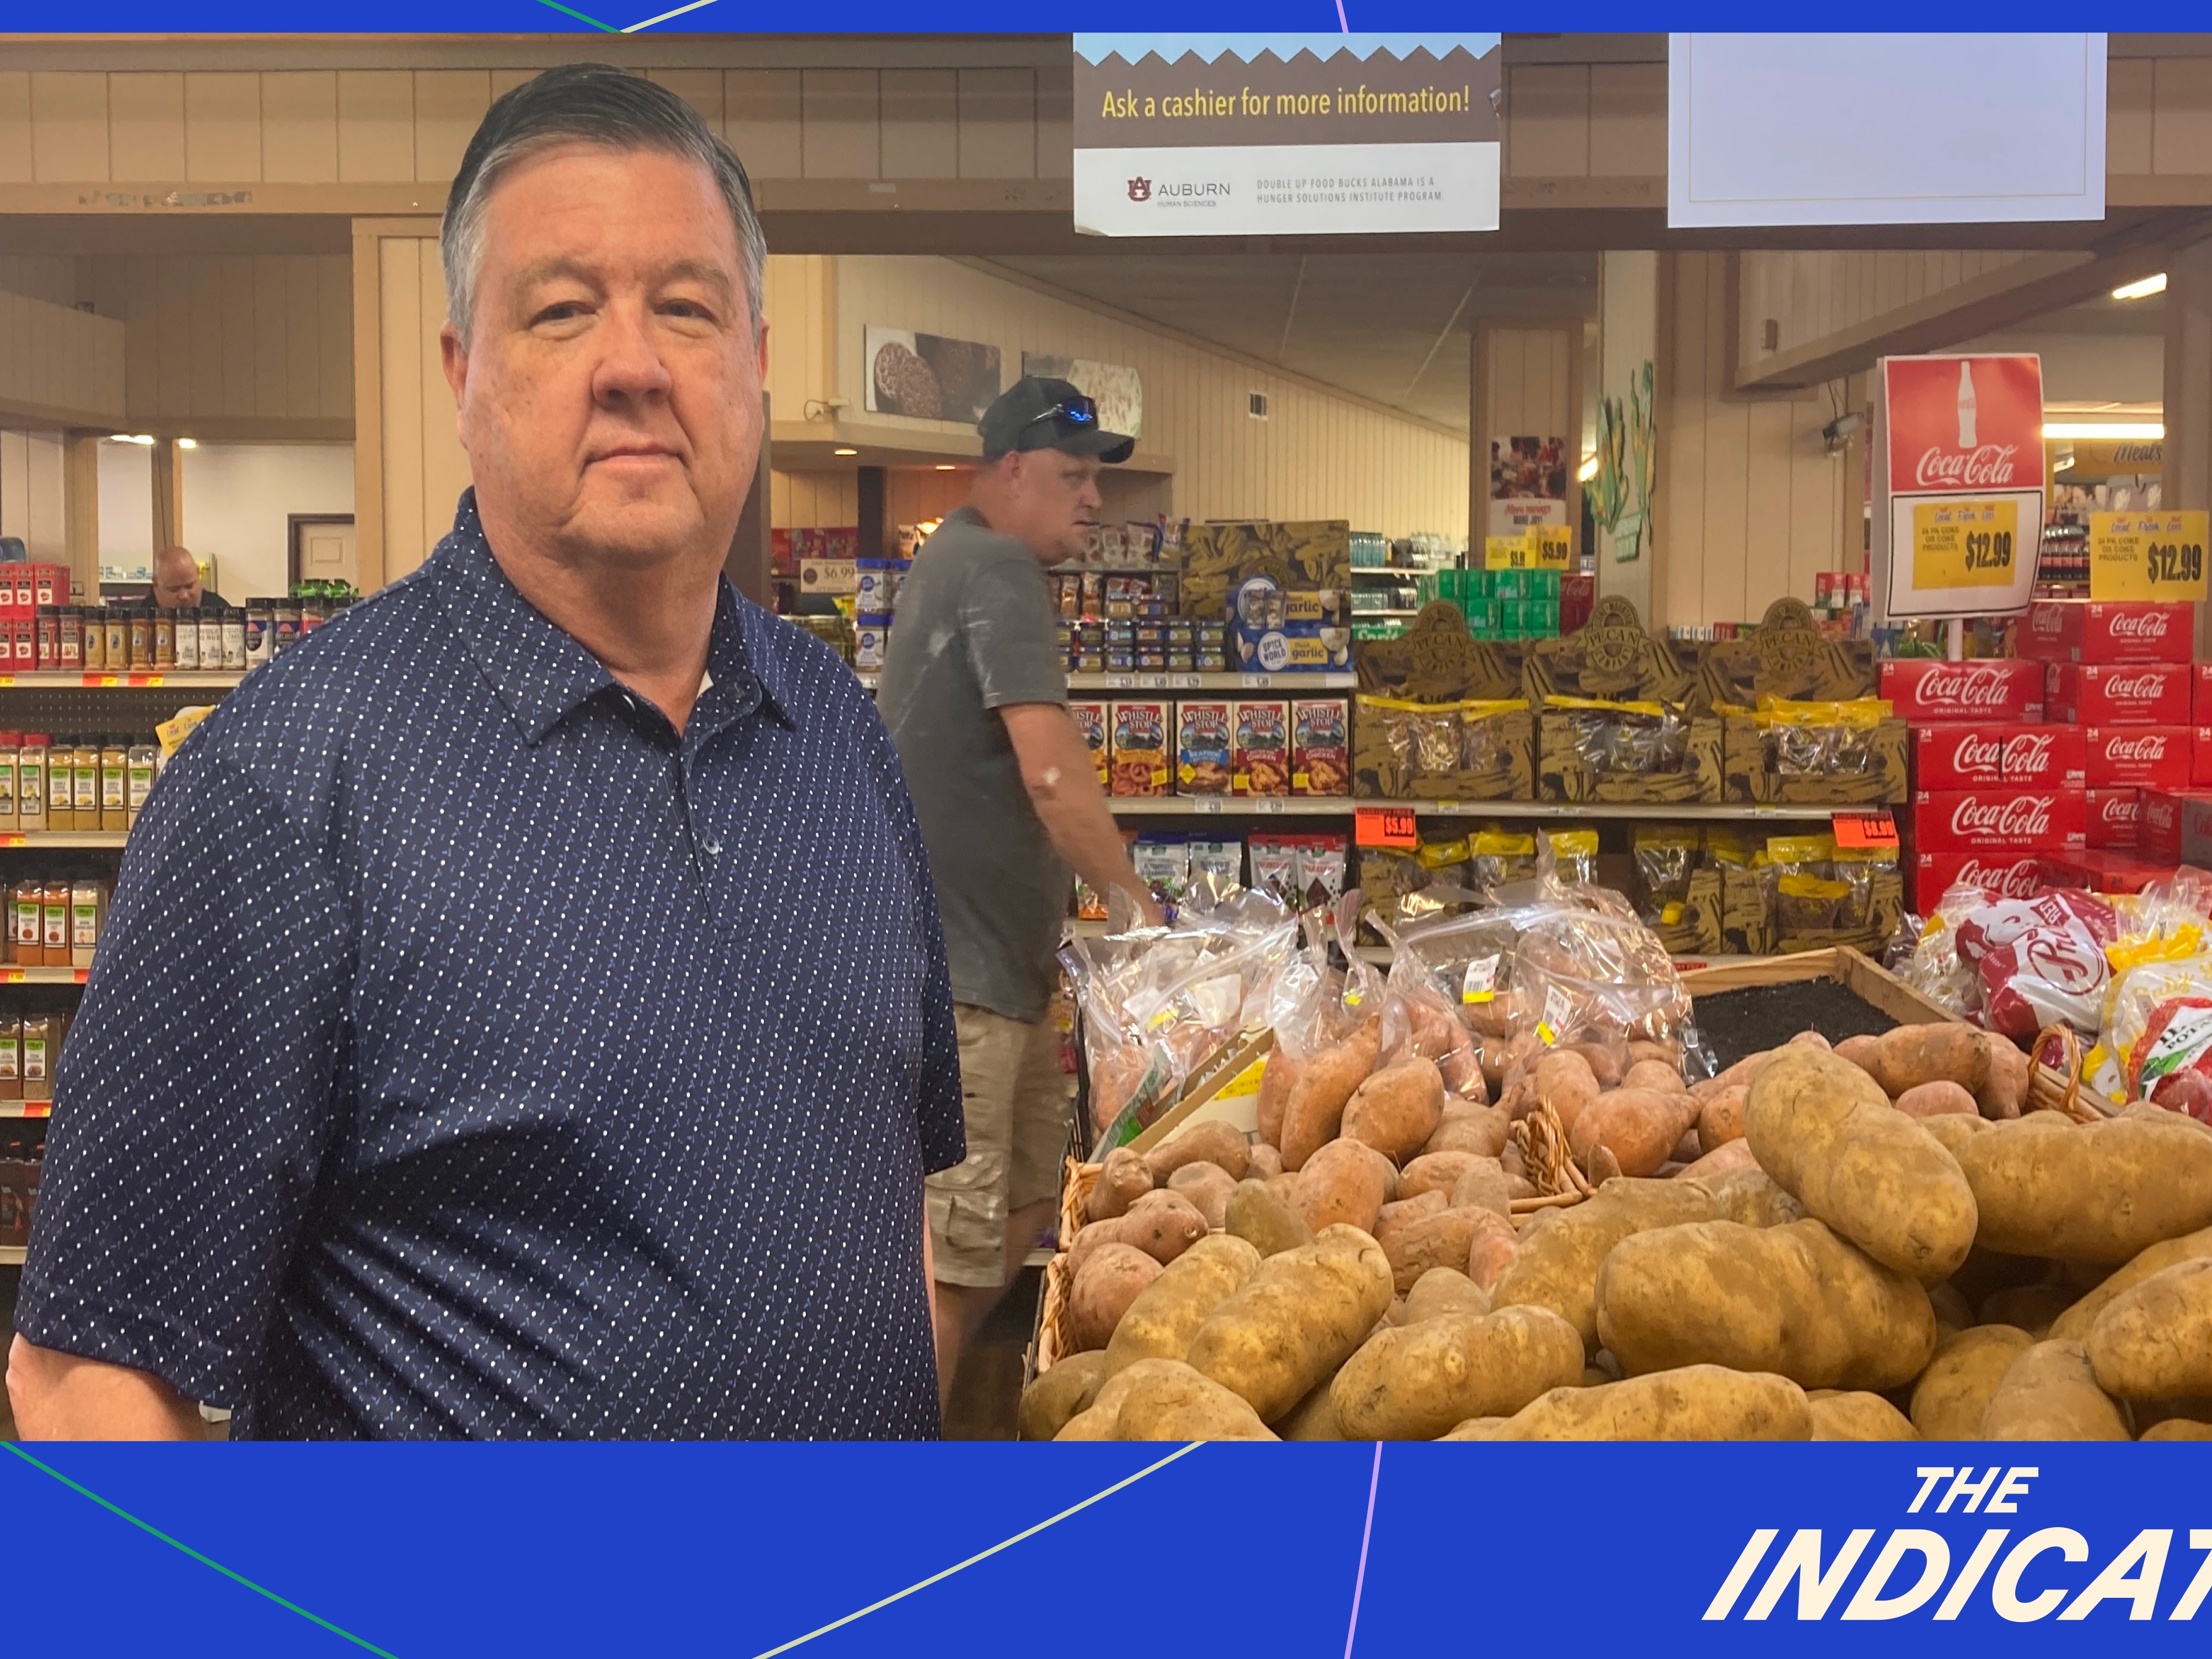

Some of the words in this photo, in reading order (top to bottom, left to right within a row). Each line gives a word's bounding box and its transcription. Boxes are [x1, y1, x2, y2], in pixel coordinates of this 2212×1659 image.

[1102, 89, 1139, 118] Ask
[1145, 96, 1156, 117] a
[1162, 87, 1236, 117] cashier
[1242, 86, 1271, 115] for
[1276, 93, 1331, 115] more
[1337, 84, 1469, 114] information!
[1158, 183, 1231, 196] AUBURN
[1257, 179, 1292, 189] DOUBLE
[1295, 179, 1307, 189] UP
[1311, 179, 1335, 188] FOOD
[1339, 178, 1367, 188] BUCKS
[1371, 177, 1413, 187] ALABAMA
[1416, 177, 1425, 187] IS
[1429, 176, 1435, 186] A
[1257, 194, 1293, 203] HUNGER
[1296, 192, 1346, 203] SOLUTIONS
[1350, 192, 1395, 202] INSTITUTE
[2113, 442, 2162, 463] Meats
[1916, 444, 2020, 487] Coca-Cola
[2118, 536, 2140, 544] COKE
[1542, 541, 1568, 561] $5.99
[1965, 530, 2012, 572] $12.99
[2098, 553, 2139, 561] PRODUCTS
[2147, 541, 2202, 584] $12.99
[824, 566, 855, 579] $6.99
[2109, 612, 2171, 637] Coca-Cola
[1263, 638, 1282, 652] SPICE
[1589, 629, 1637, 647] PECAN
[1765, 631, 1813, 649] PECAN
[1264, 648, 1286, 663] WORLD
[1291, 647, 1324, 661] garlic
[1882, 663, 1894, 672] 24
[2086, 666, 2098, 674] 24
[1915, 668, 2014, 706] Coca-Cola
[2104, 673, 2167, 699] Coca-Cola
[1116, 709, 1163, 724] WHISTLE
[1181, 709, 1230, 724] WHISTLE
[1238, 708, 1286, 723] WHISTLE
[1297, 706, 1345, 722] WHISTLE
[1129, 720, 1154, 729] STOP
[1195, 719, 1219, 729] STOP
[1250, 718, 1275, 728] STOP
[1310, 717, 1334, 727] STOP
[1920, 729, 1932, 737] 24
[2086, 728, 2098, 737] 24
[2199, 727, 2211, 736] 24
[1953, 733, 2055, 773] Coca-Cola
[2105, 735, 2168, 760] Coca-Cola
[1917, 791, 1929, 799] 24
[1951, 795, 2055, 836] Coca-Cola
[1385, 817, 1414, 835] $5.99
[1920, 853, 1932, 862] 24
